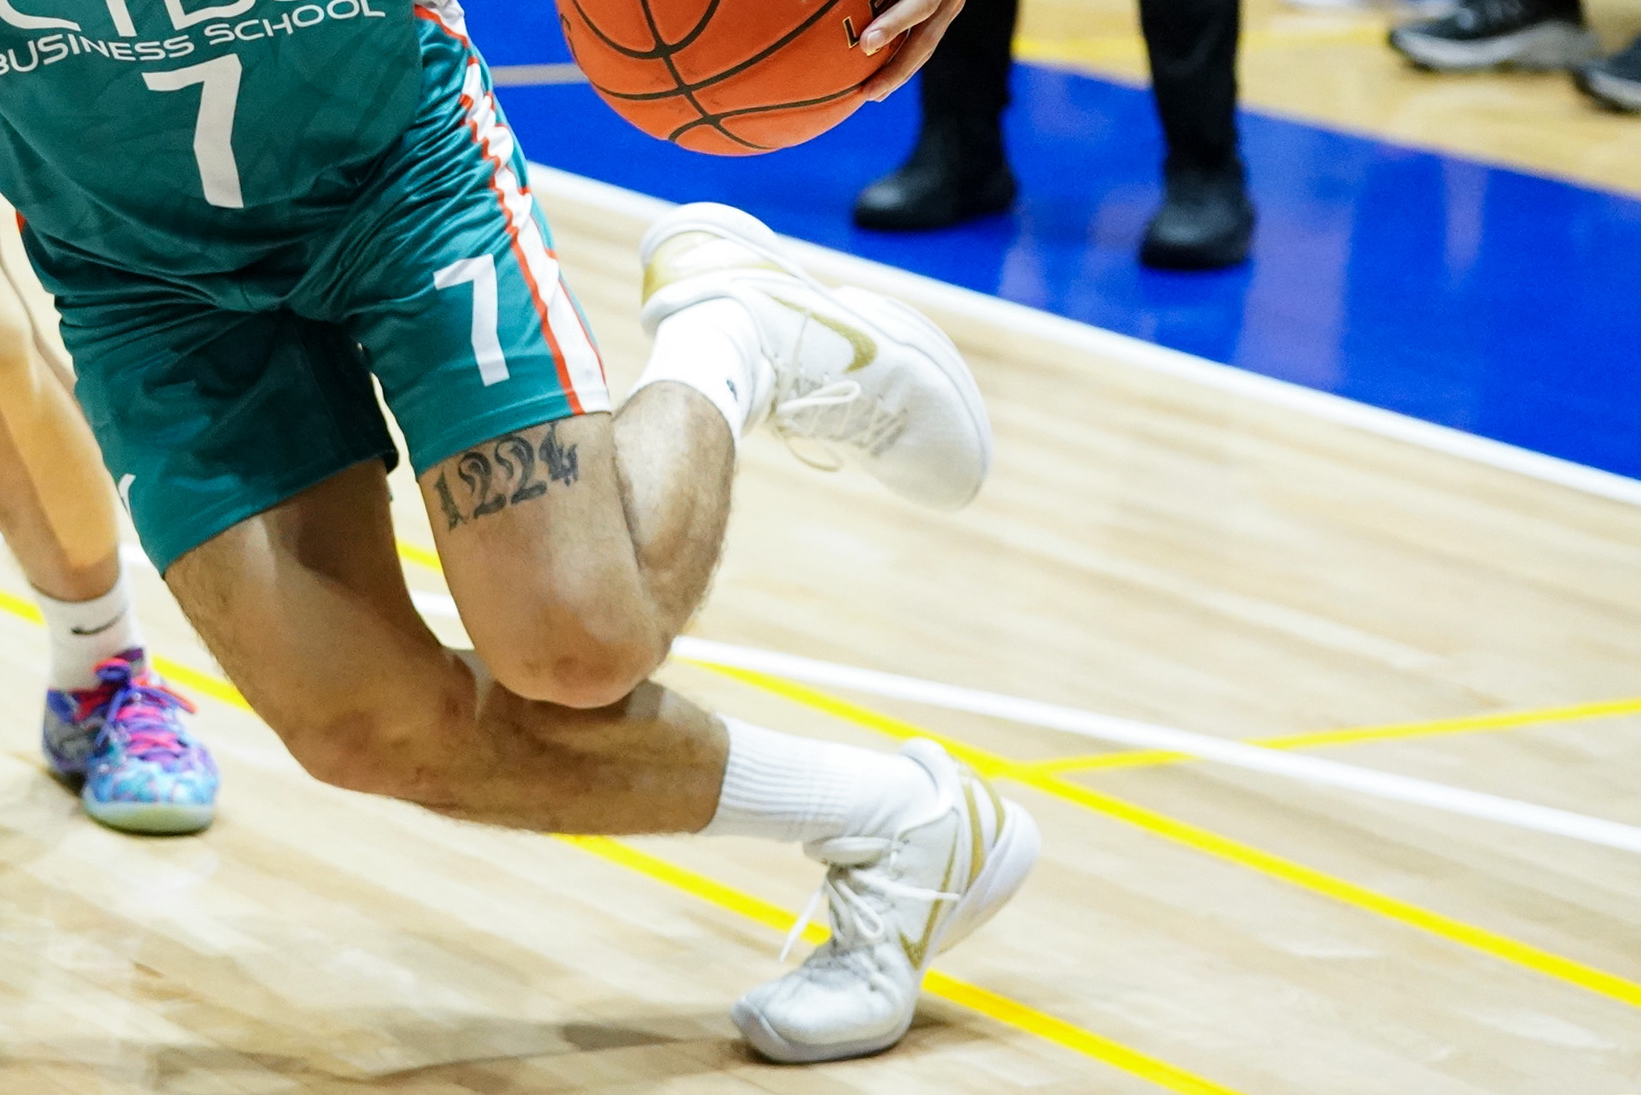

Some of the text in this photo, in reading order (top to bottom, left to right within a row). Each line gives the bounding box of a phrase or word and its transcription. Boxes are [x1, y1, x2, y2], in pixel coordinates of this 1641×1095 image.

[141, 53, 244, 209] 7
[433, 253, 510, 387] 7
[433, 420, 579, 532] 1224
